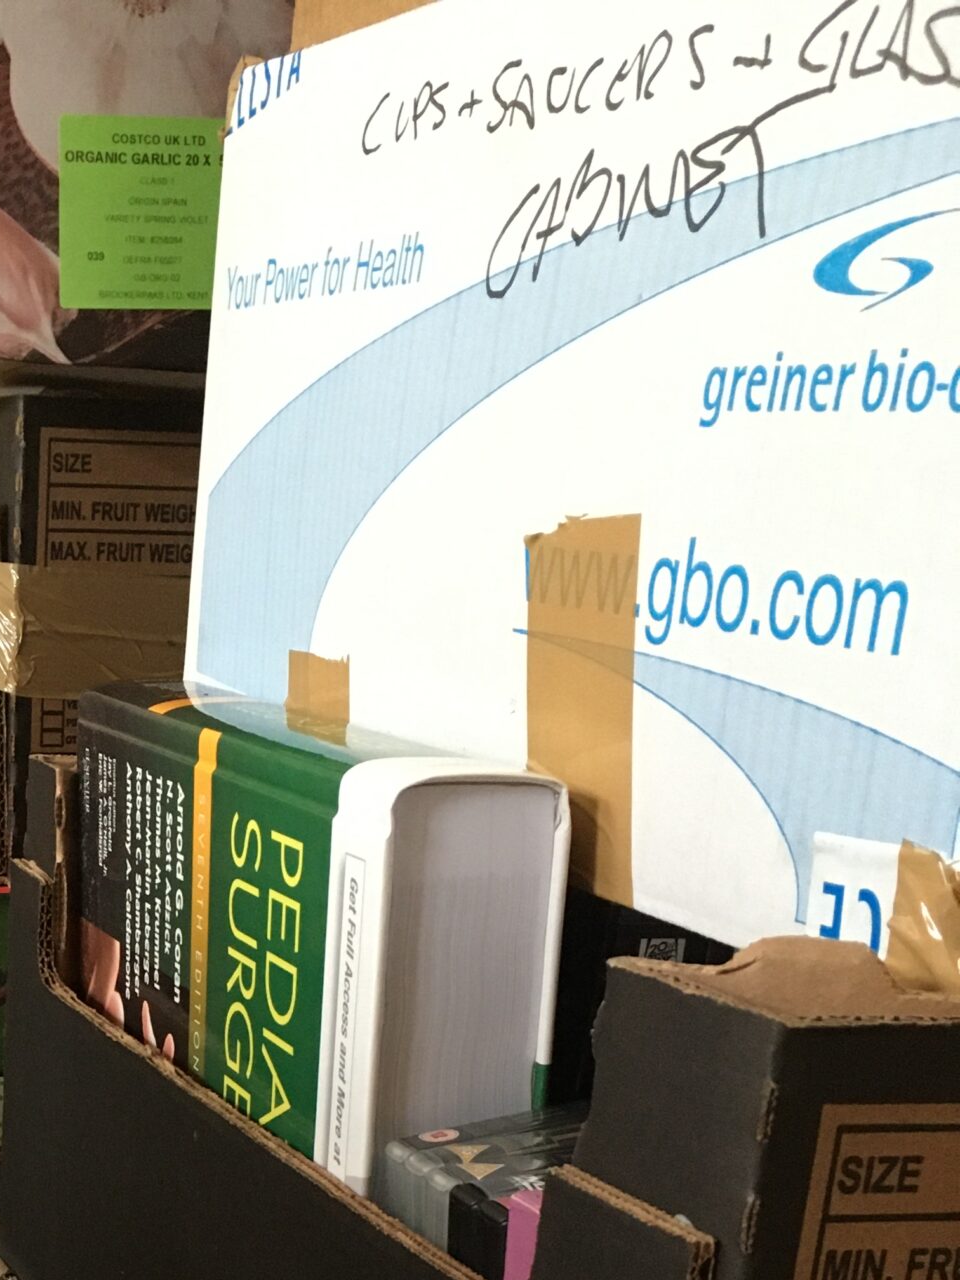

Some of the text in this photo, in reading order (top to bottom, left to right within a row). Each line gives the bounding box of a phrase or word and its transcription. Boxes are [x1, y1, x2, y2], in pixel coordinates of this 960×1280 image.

[65, 150, 127, 165] ORGANIC
[131, 151, 181, 166] GARLIC
[185, 153, 199, 166] 20
[202, 154, 211, 167] X
[112, 133, 206, 147] COSTCO UK LTD
[87, 251, 105, 261] 039
[227, 231, 425, 310] Your Power for Health
[699, 351, 857, 428] greiner
[52, 453, 92, 473] SIZE
[51, 500, 86, 520] MIN.
[91, 502, 140, 522] FRUIT
[50, 541, 90, 561] MAX.
[96, 542, 145, 562] FRUIT
[125, 761, 133, 854] Anthony
[155, 776, 163, 858] Thomas
[165, 812, 173, 873] Scott
[143, 770, 152, 985] Jean-Martin Laberge
[164, 877, 172, 954] Adzick
[174, 782, 186, 1004] Arnold G. Coran
[134, 867, 142, 997] Shamberger
[153, 897, 161, 990] Krummel
[192, 793, 207, 1072] SEVENTH EDITION
[258, 829, 304, 1126] PEDIA
[333, 877, 358, 1166] Get Full Access and More at
[837, 1155, 924, 1194] SIZE
